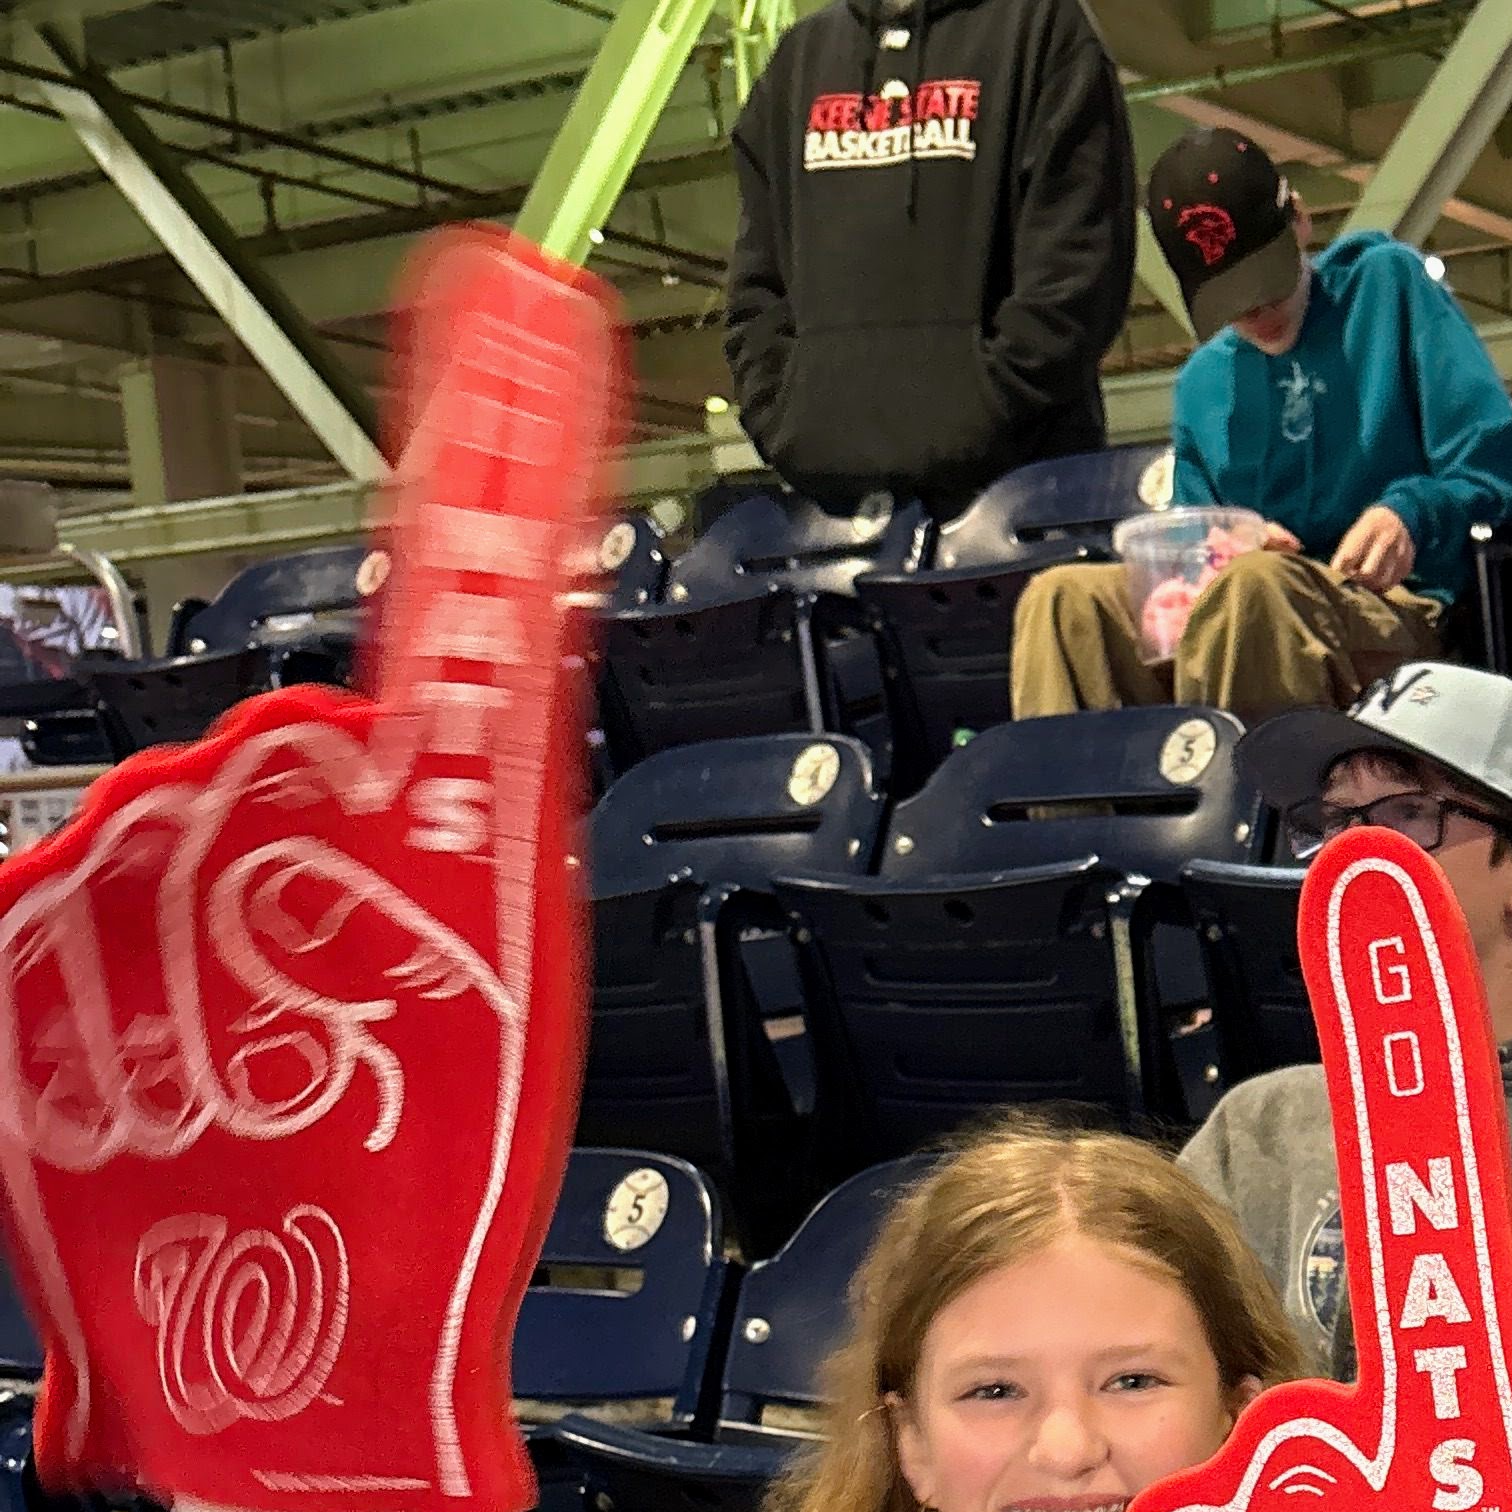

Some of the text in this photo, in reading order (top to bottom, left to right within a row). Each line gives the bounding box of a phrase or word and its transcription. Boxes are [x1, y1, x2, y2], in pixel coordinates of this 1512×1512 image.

[1180, 737, 1197, 765] 5
[1368, 936, 1425, 1098] GO
[626, 1195, 645, 1225] 5
